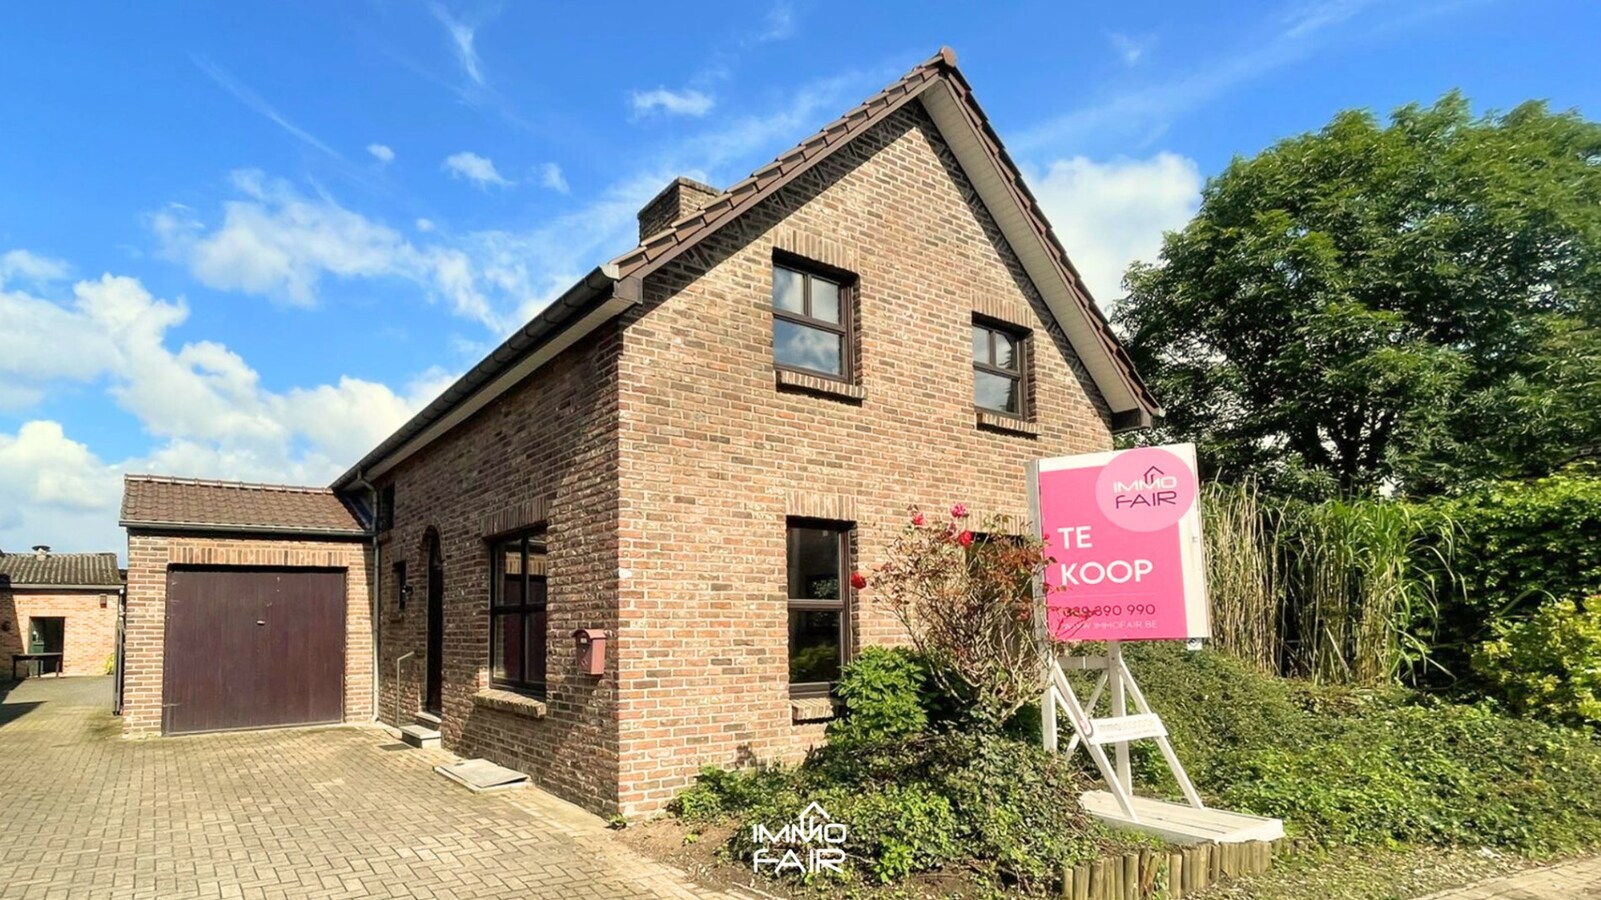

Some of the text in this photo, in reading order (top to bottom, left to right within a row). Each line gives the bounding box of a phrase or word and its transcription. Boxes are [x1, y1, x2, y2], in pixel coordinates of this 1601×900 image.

[1113, 476, 1177, 493] IMMO
[1115, 490, 1177, 509] FAIR
[1057, 526, 1092, 550] TE
[1061, 560, 1153, 586] KOOP
[1094, 605, 1122, 617] 890
[1127, 603, 1156, 615] 990
